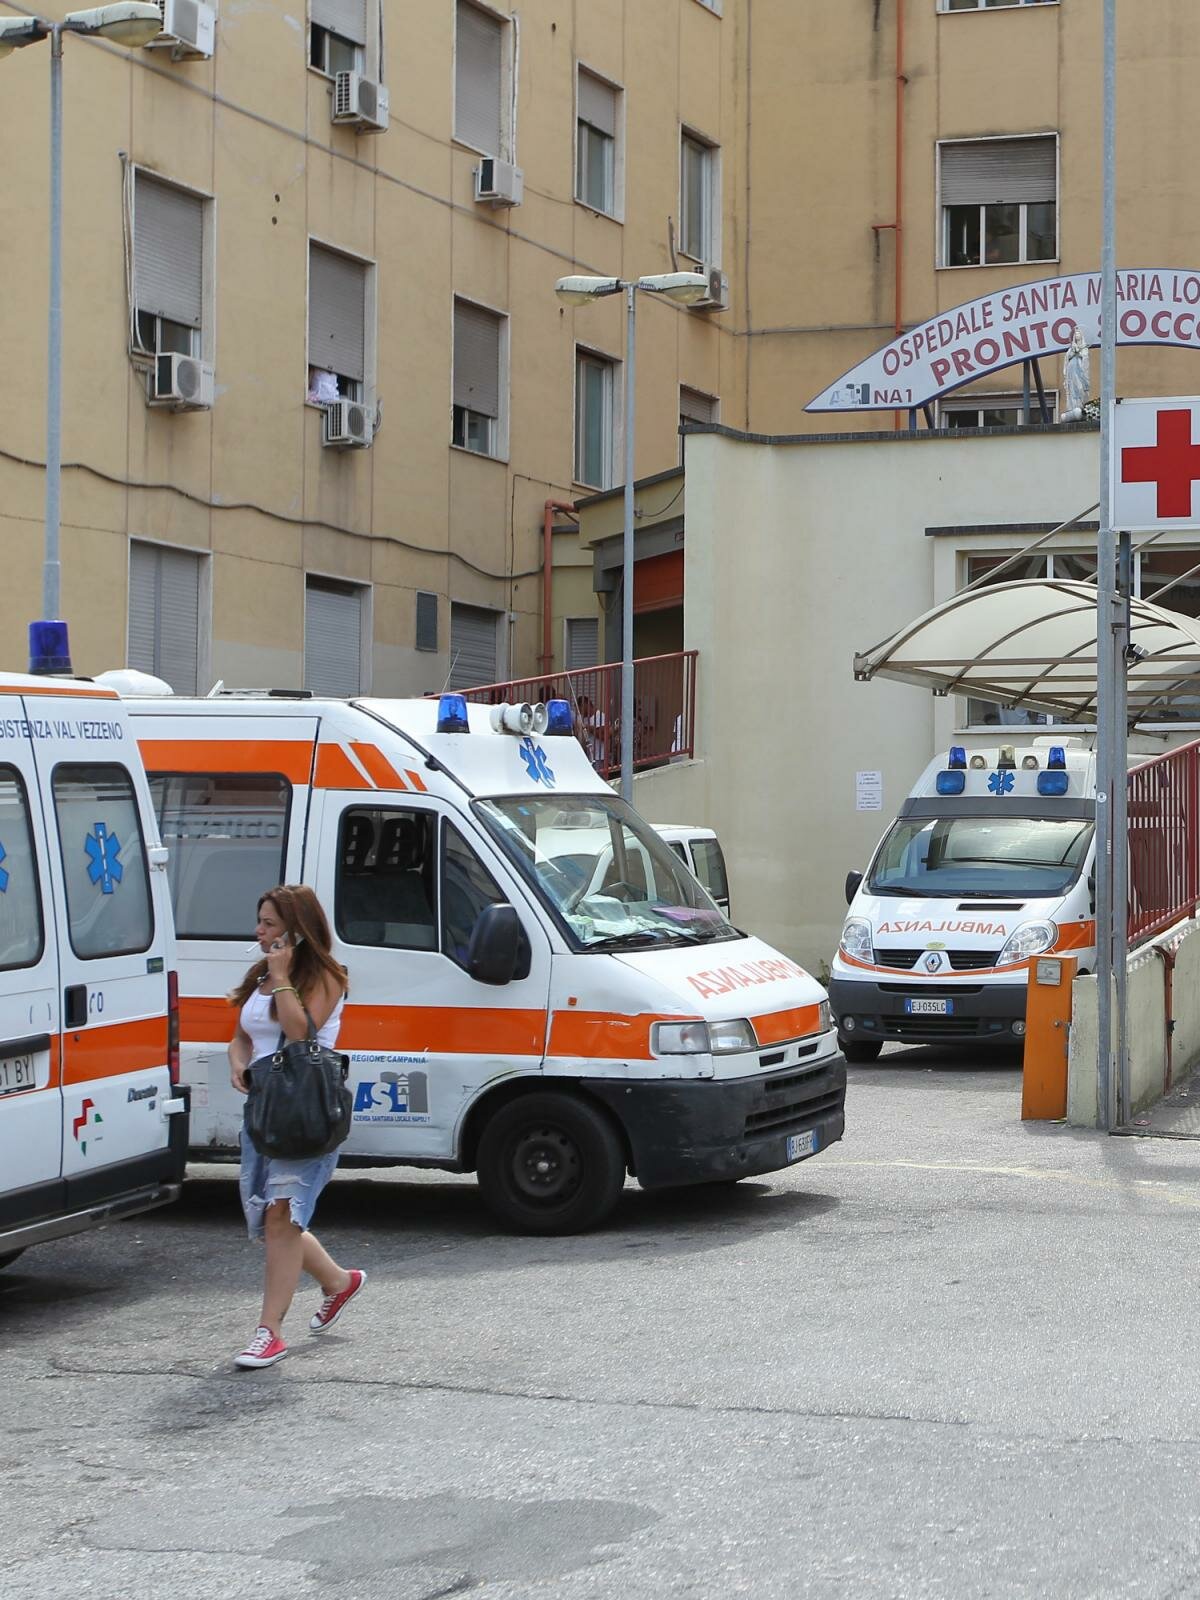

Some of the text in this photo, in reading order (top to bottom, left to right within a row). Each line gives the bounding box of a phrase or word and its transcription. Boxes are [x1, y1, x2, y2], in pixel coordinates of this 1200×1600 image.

[882, 300, 995, 376] OSPEDALE
[1001, 280, 1078, 322] SANTA
[930, 317, 1077, 386] PRONTO
[54, 721, 76, 739] VAL
[76, 721, 123, 740] VEZZENO
[15, 1056, 29, 1083] BY
[351, 1054, 426, 1064] REGIONE CAMPANIA
[353, 1082, 408, 1112] ASL
